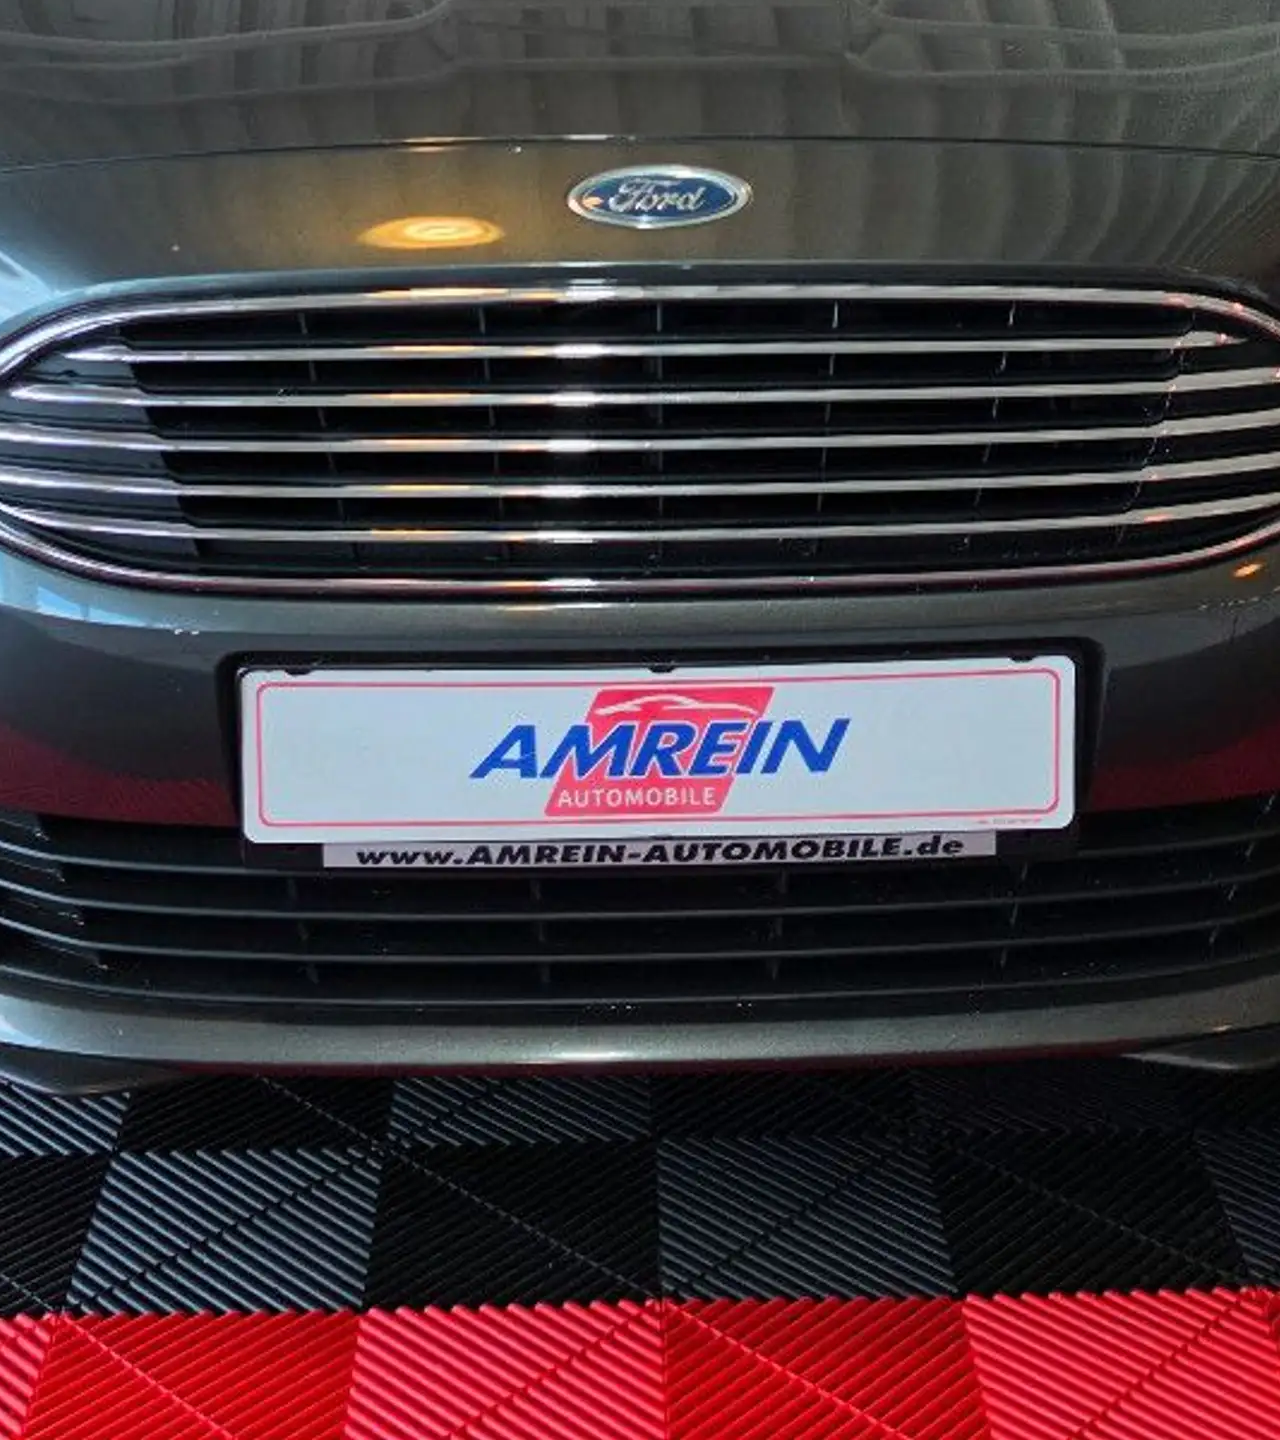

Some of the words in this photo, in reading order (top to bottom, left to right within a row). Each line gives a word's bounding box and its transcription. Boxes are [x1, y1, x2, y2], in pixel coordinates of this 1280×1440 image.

[608, 177, 707, 213] Ford
[469, 717, 851, 779] AMREIN
[557, 786, 717, 809] AUTOMOBILE
[355, 834, 965, 868] www.AMREIN-AUTOMOBILE.de
